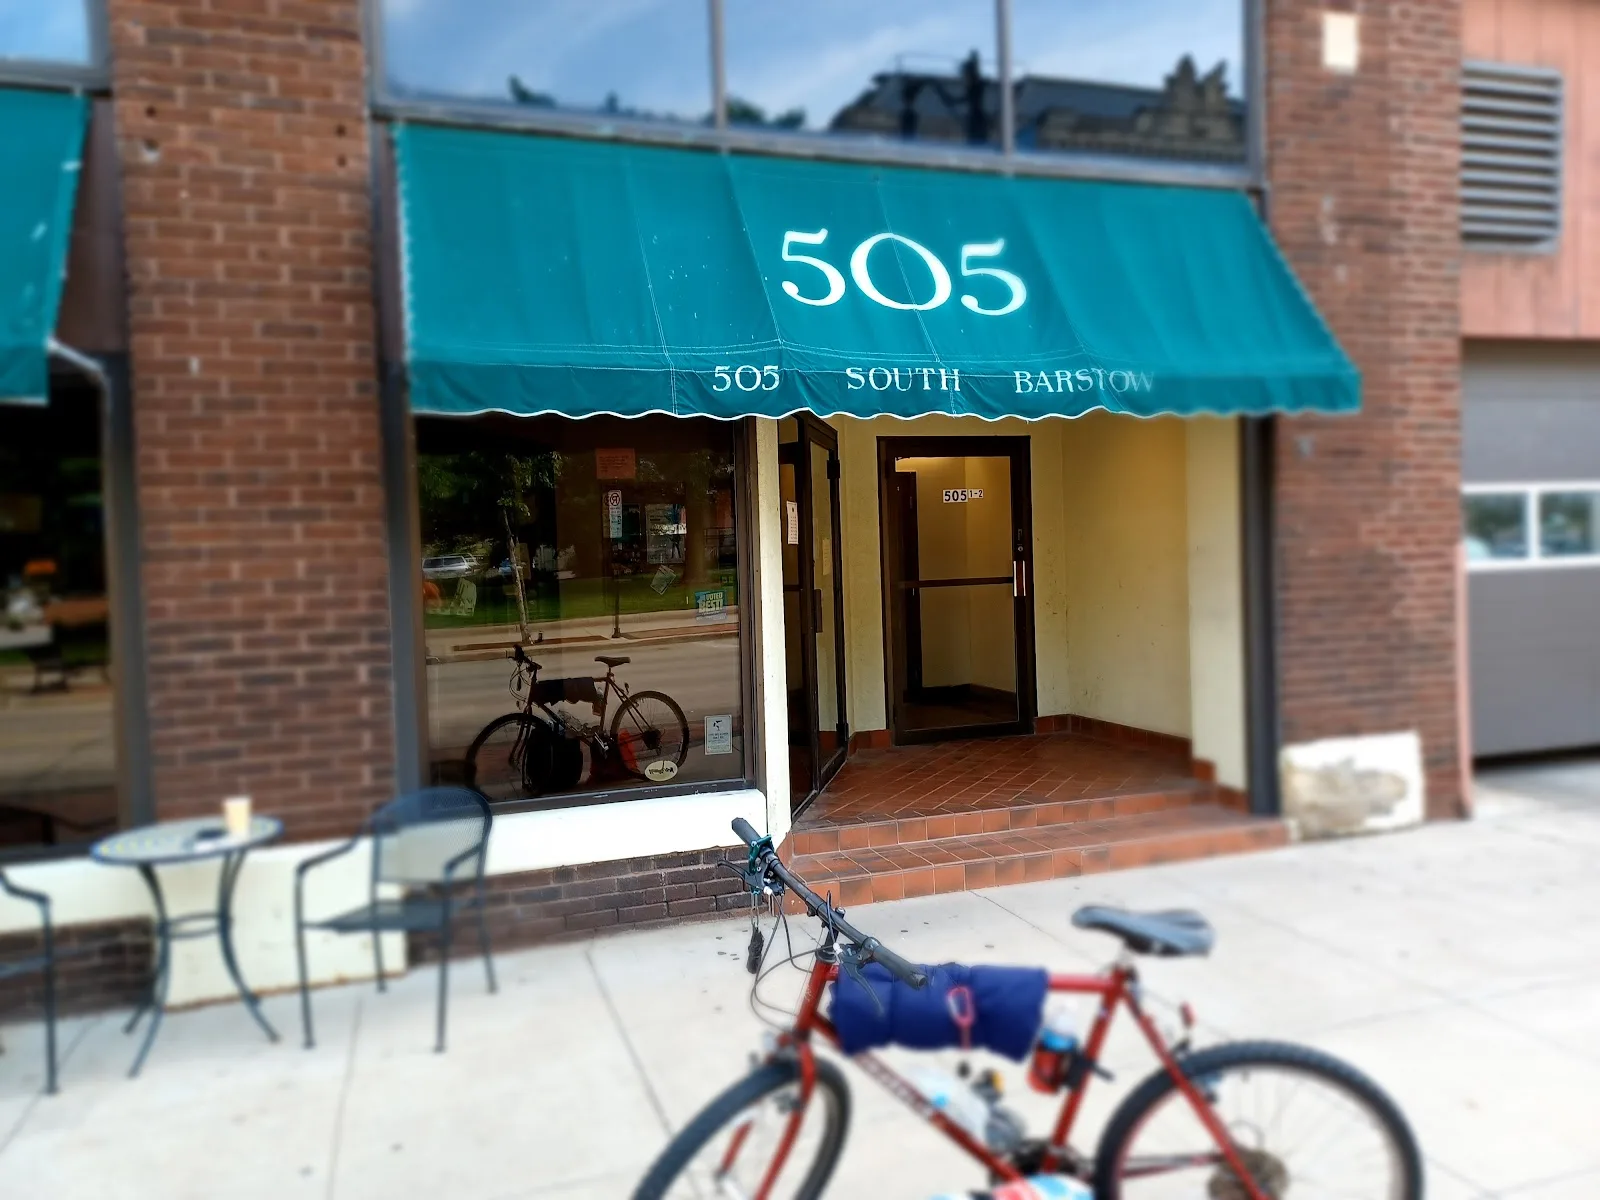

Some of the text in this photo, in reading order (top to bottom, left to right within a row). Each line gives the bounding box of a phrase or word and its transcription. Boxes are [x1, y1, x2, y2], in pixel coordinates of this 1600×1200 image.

[781, 228, 1027, 316] 505
[712, 365, 1155, 394] 505 SOUTH BARSTOW
[944, 489, 983, 501] 505 1-2
